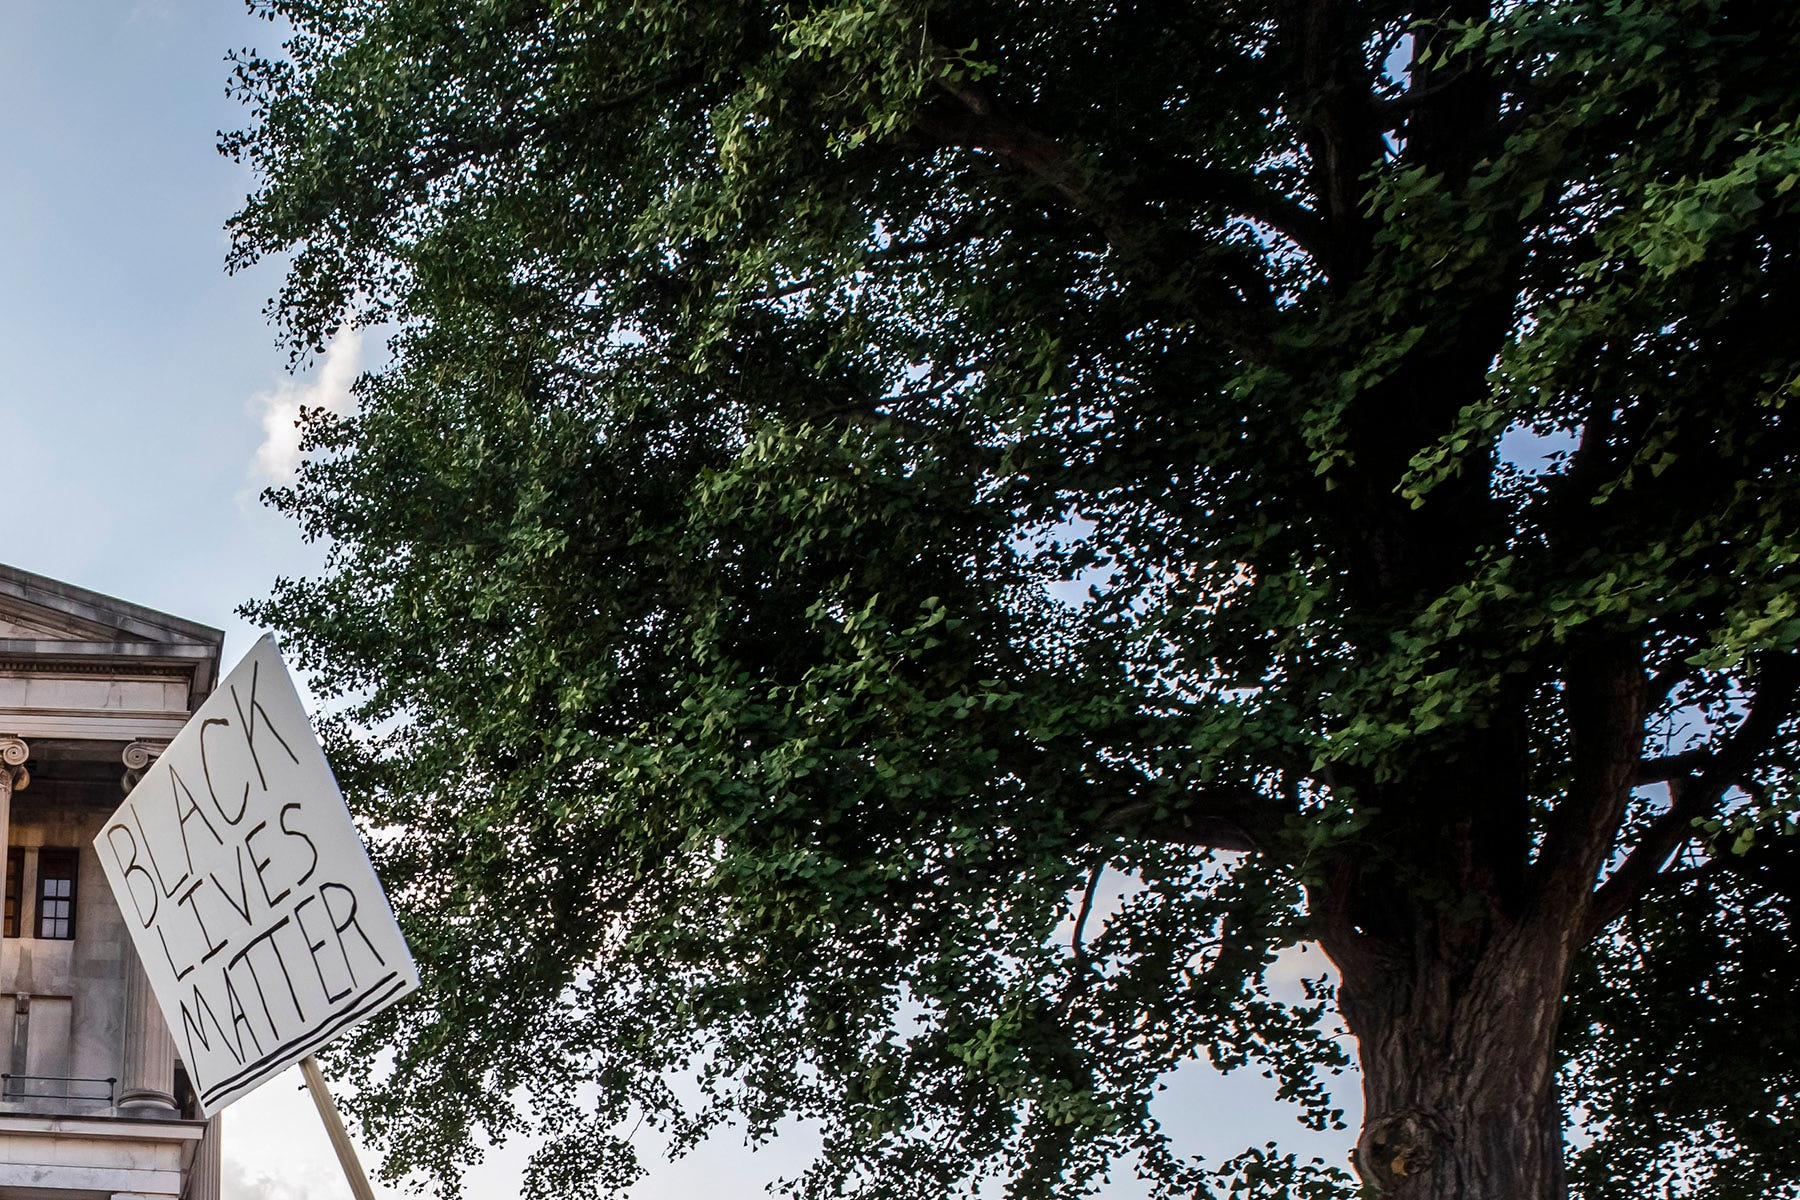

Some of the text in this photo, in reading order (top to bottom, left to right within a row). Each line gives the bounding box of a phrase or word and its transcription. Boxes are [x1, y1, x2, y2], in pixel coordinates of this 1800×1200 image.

[107, 661, 299, 928] BLACK
[156, 803, 318, 982] LIVES
[179, 882, 385, 1091] MATTER
